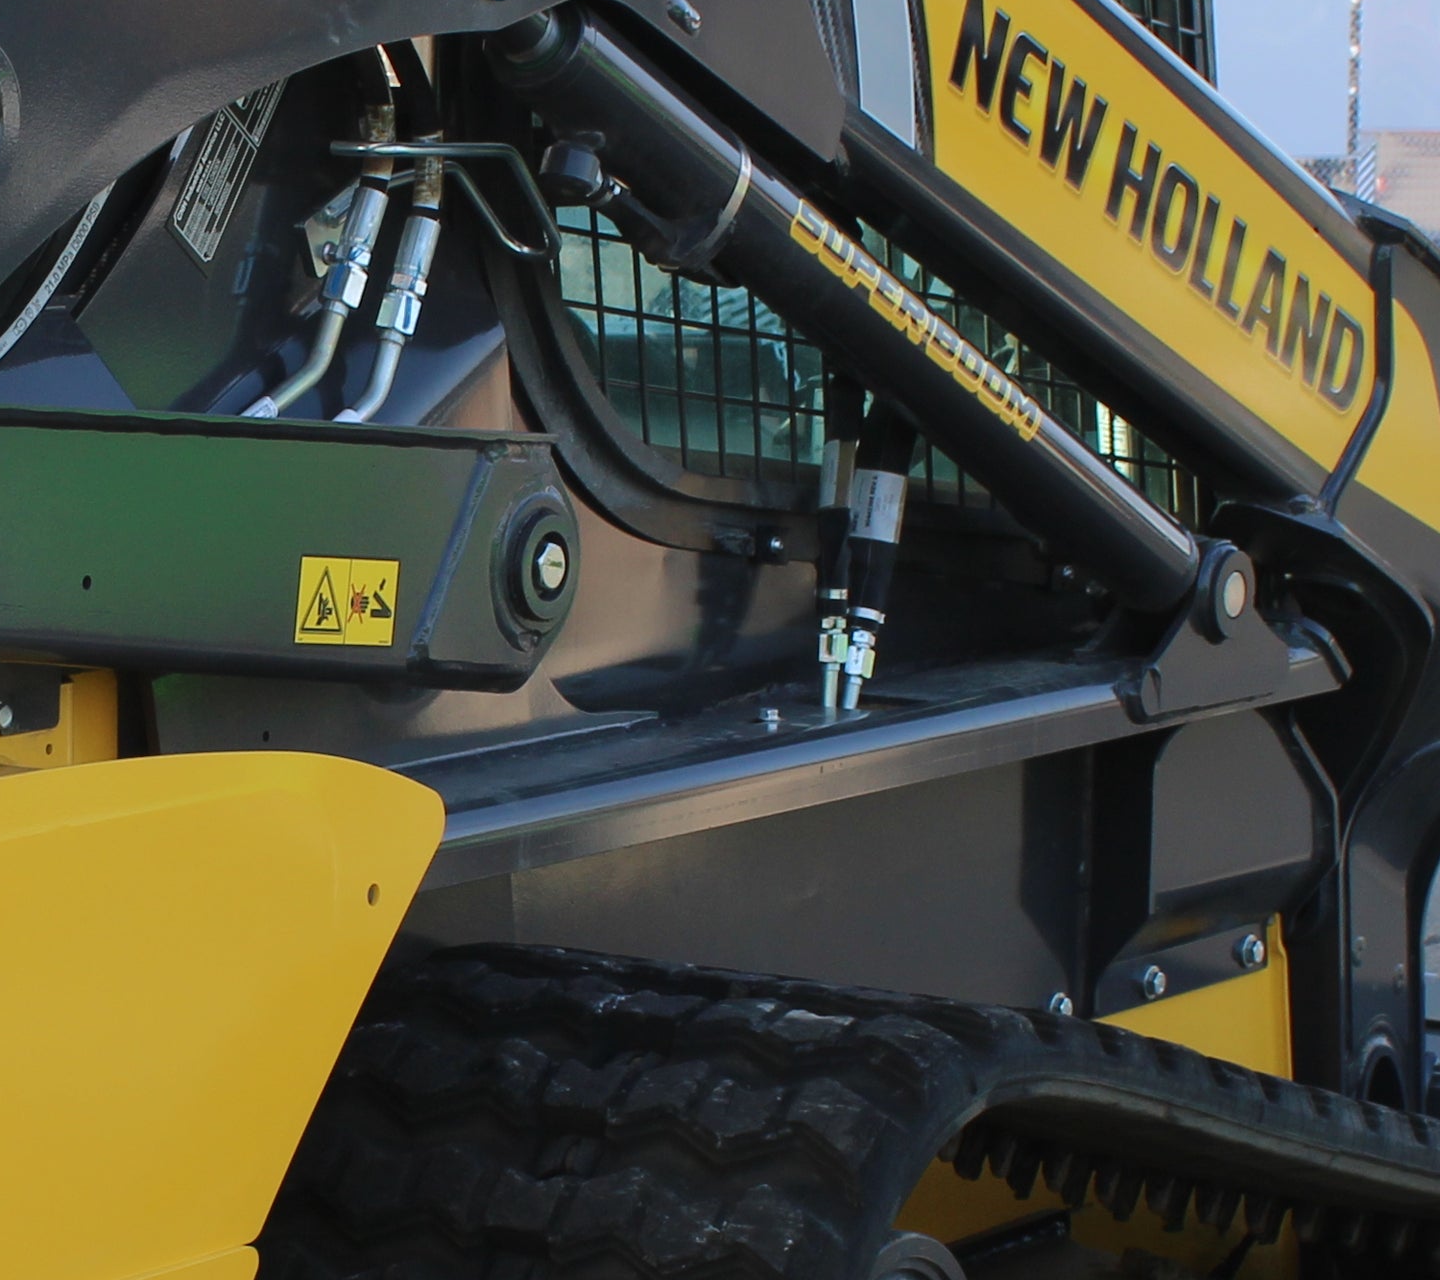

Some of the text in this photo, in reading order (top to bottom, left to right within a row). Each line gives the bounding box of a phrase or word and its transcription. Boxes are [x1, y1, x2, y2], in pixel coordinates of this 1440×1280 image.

[44, 271, 61, 295] 21.0
[56, 249, 75, 274] MPa
[1105, 119, 1366, 413] HOLLAND
